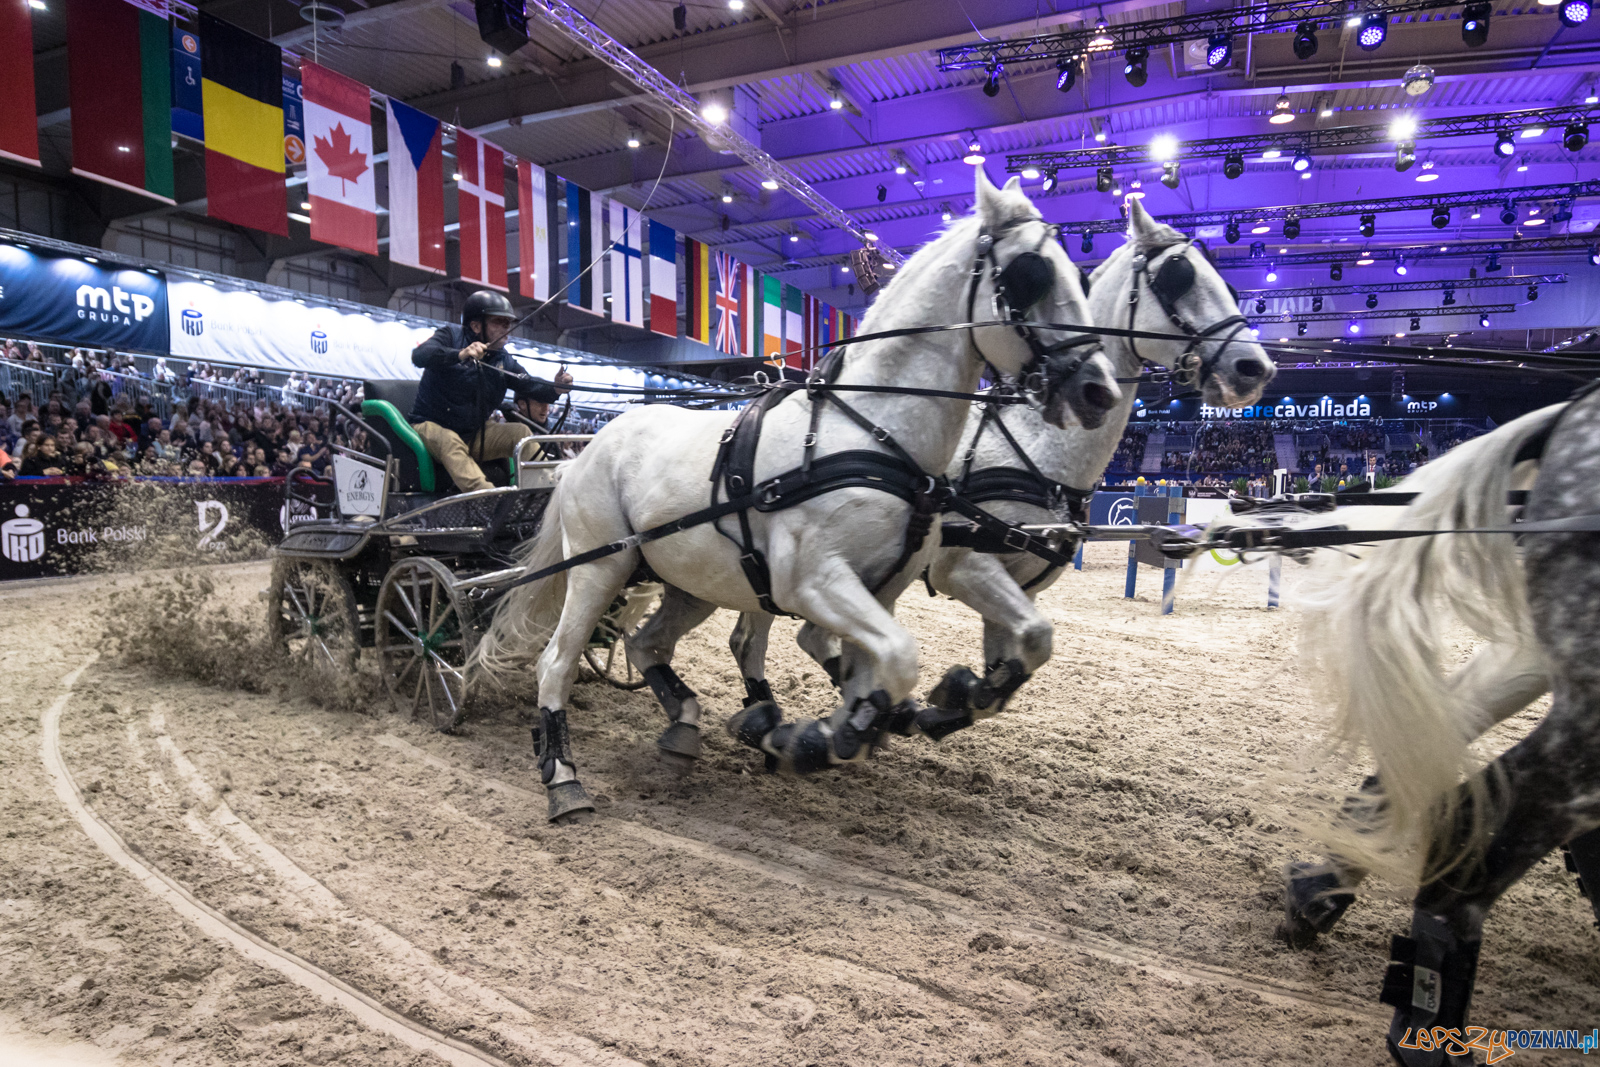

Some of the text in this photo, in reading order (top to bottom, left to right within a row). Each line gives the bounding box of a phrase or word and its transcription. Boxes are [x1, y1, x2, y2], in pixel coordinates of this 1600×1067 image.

[76, 284, 154, 321] mtp
[77, 309, 131, 326] GRUPA
[1199, 399, 1371, 418] #wearecavaliada
[1407, 400, 1437, 411] mtp
[346, 491, 375, 502] ENERGYS
[56, 527, 98, 545] Bank
[103, 525, 147, 541] Polski
